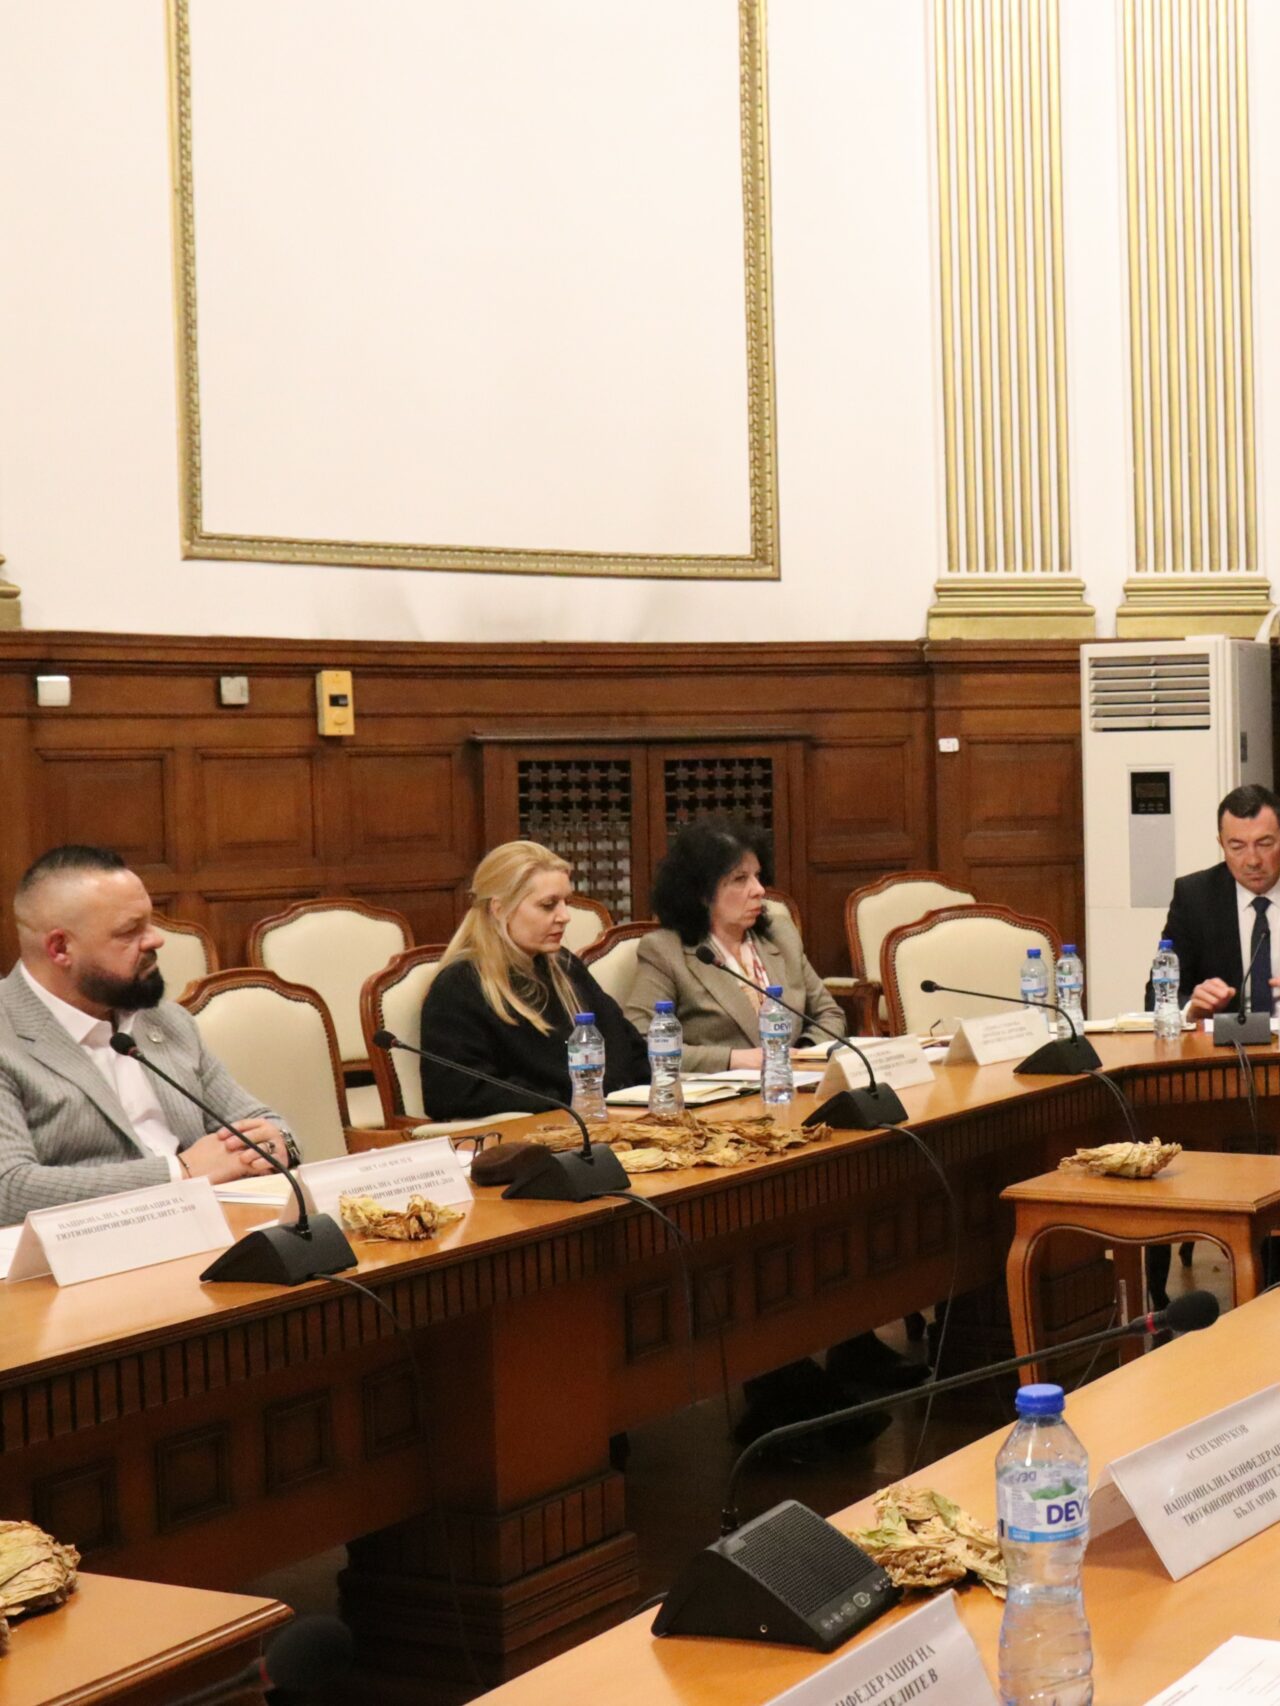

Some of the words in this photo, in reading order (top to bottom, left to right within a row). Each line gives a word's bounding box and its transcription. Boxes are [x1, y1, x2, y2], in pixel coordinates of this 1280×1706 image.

[773, 1023, 790, 1031] DEV
[1186, 1444, 1209, 1461] АСЕН
[1046, 1495, 1088, 1525] DEV
[1233, 1488, 1278, 1520] БЪЛГАРИЯ
[915, 1644, 936, 1662] НА
[928, 1667, 938, 1684] В
